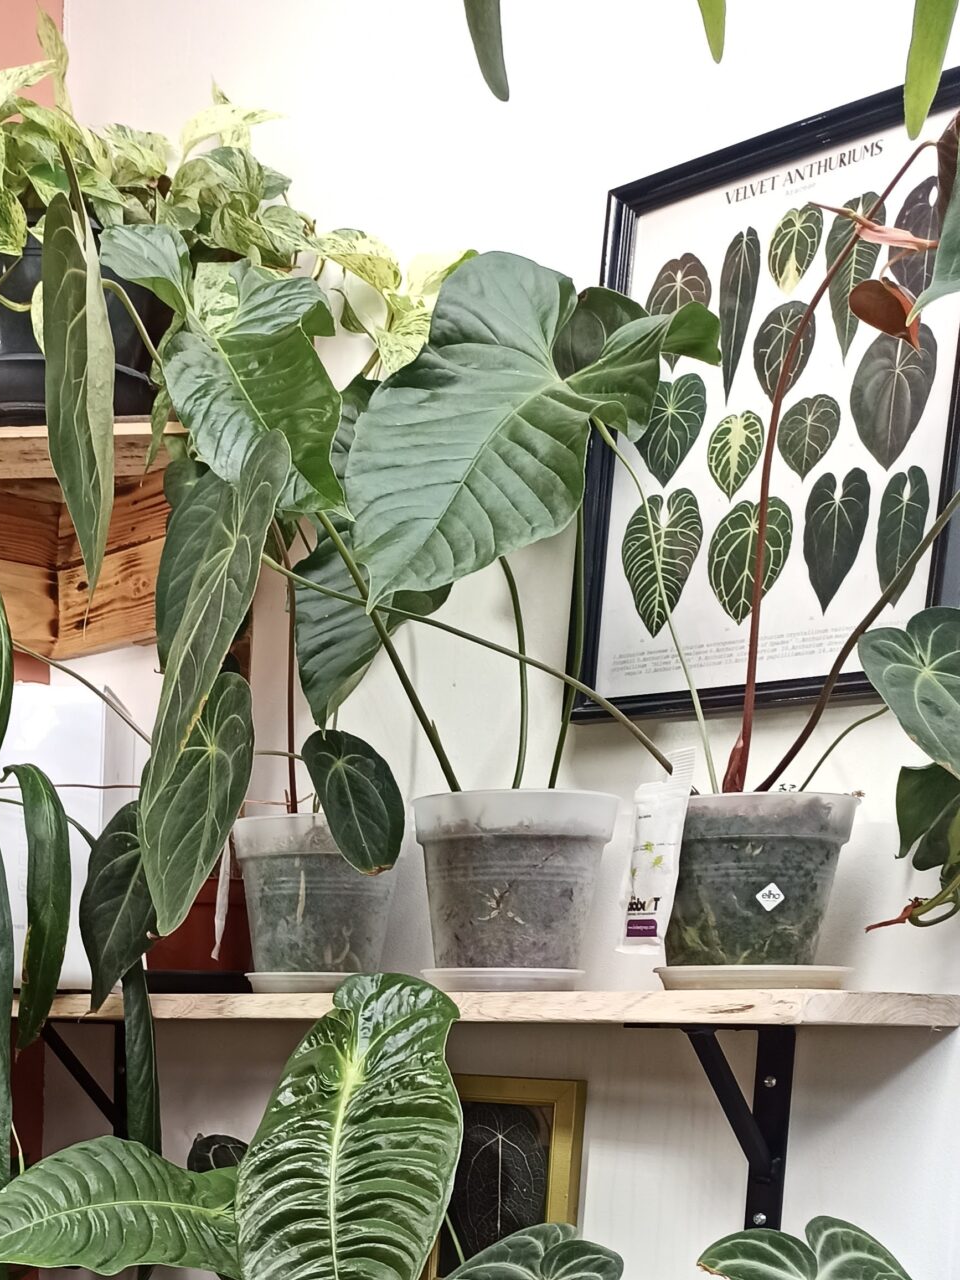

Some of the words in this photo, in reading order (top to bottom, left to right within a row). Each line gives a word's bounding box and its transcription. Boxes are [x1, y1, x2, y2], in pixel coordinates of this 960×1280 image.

[725, 175, 780, 204] VELVET
[782, 139, 884, 187] ANTHURIUMS
[761, 890, 781, 900] elho
